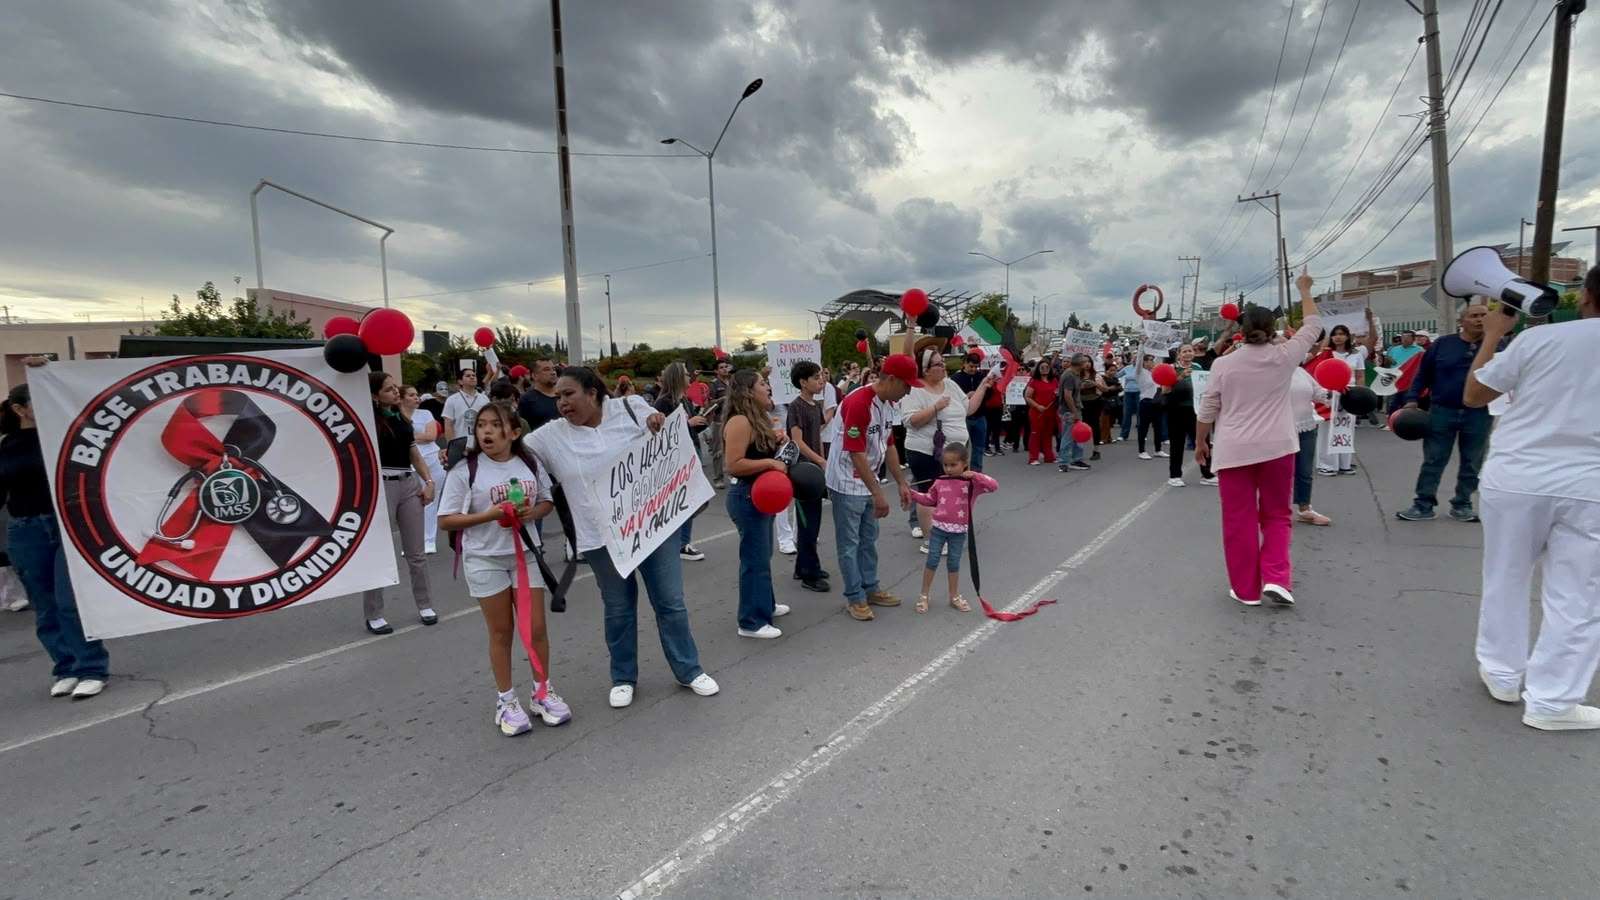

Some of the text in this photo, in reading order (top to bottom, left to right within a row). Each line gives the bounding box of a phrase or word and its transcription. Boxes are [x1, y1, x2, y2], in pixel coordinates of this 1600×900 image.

[70, 363, 357, 467] BASE TRABAJADORA
[610, 413, 681, 498] LOS HEROES
[214, 503, 252, 518] IMSS
[612, 447, 681, 525] del COVID
[619, 454, 697, 541] YA VOLVIMOS
[631, 485, 689, 558] A SALIR
[100, 511, 363, 609] UNIDAD Y DIGNIDAD
